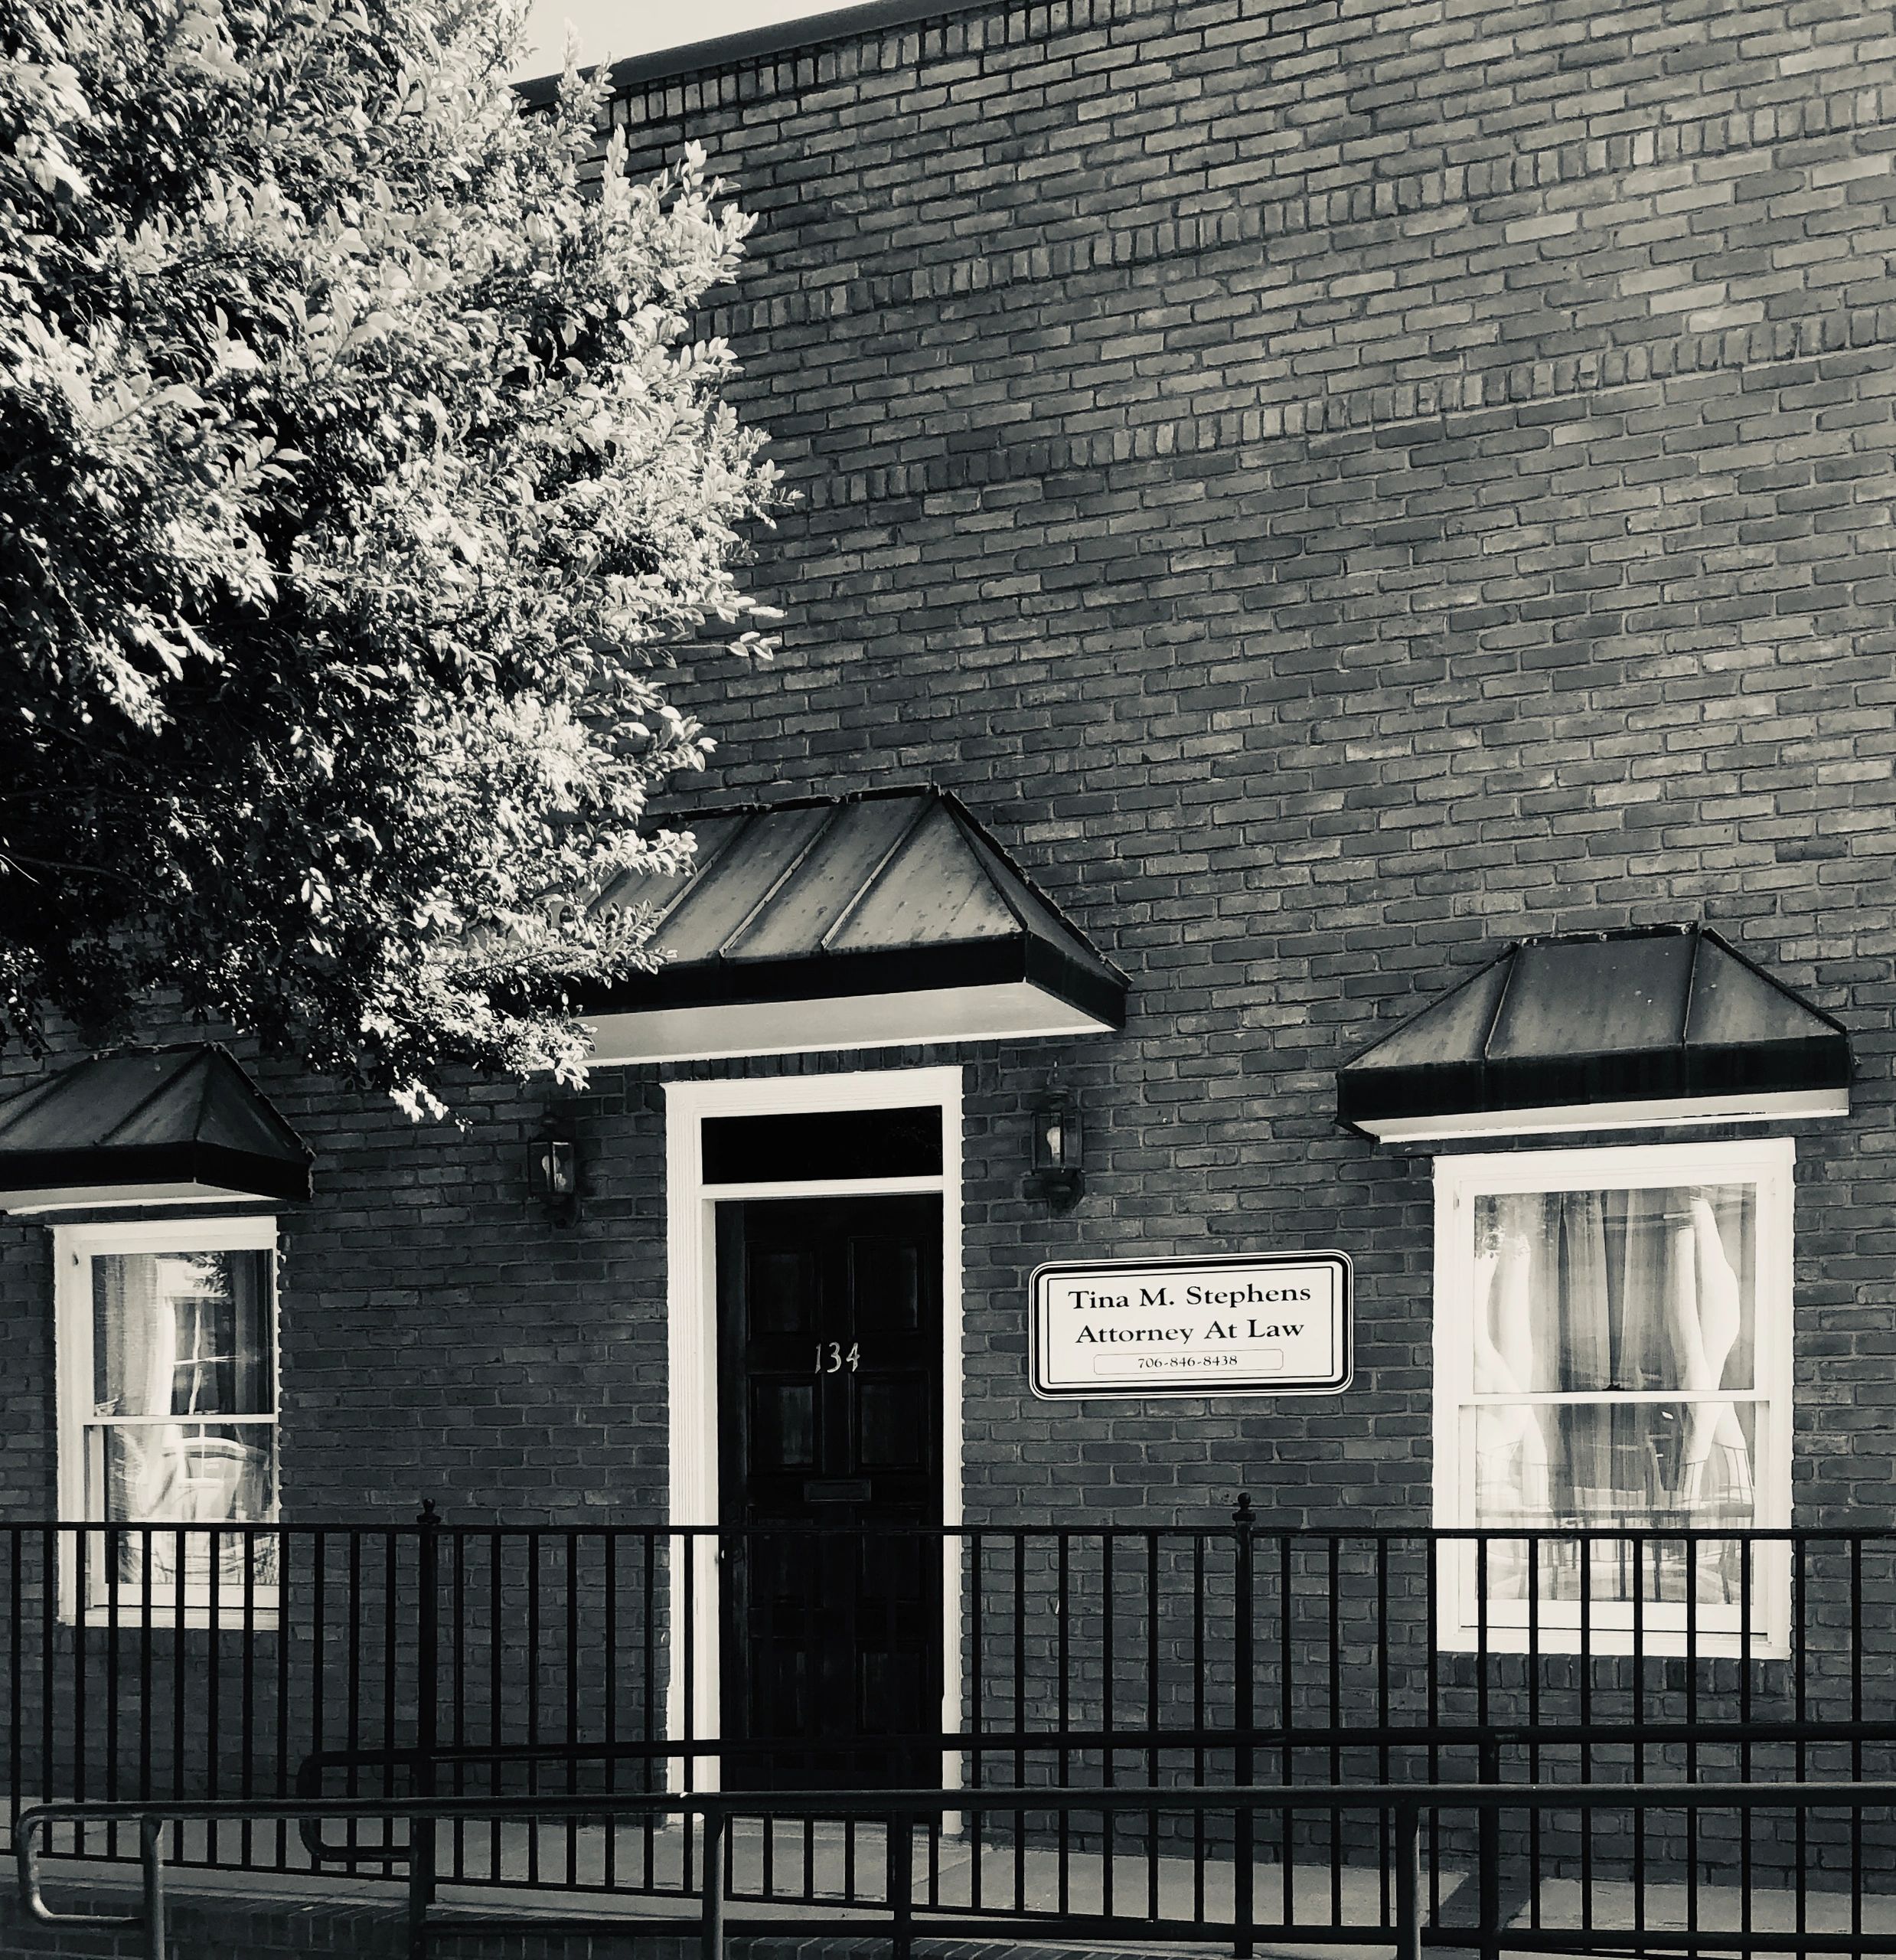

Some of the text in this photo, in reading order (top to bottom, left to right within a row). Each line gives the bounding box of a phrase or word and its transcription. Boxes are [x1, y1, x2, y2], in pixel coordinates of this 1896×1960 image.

[1068, 1283, 1311, 1309] Tina M. Stephens
[1075, 1318, 1304, 1344] Attorney At Law
[814, 1341, 860, 1374] 134
[1137, 1355, 1238, 1369] 706-846-8438
